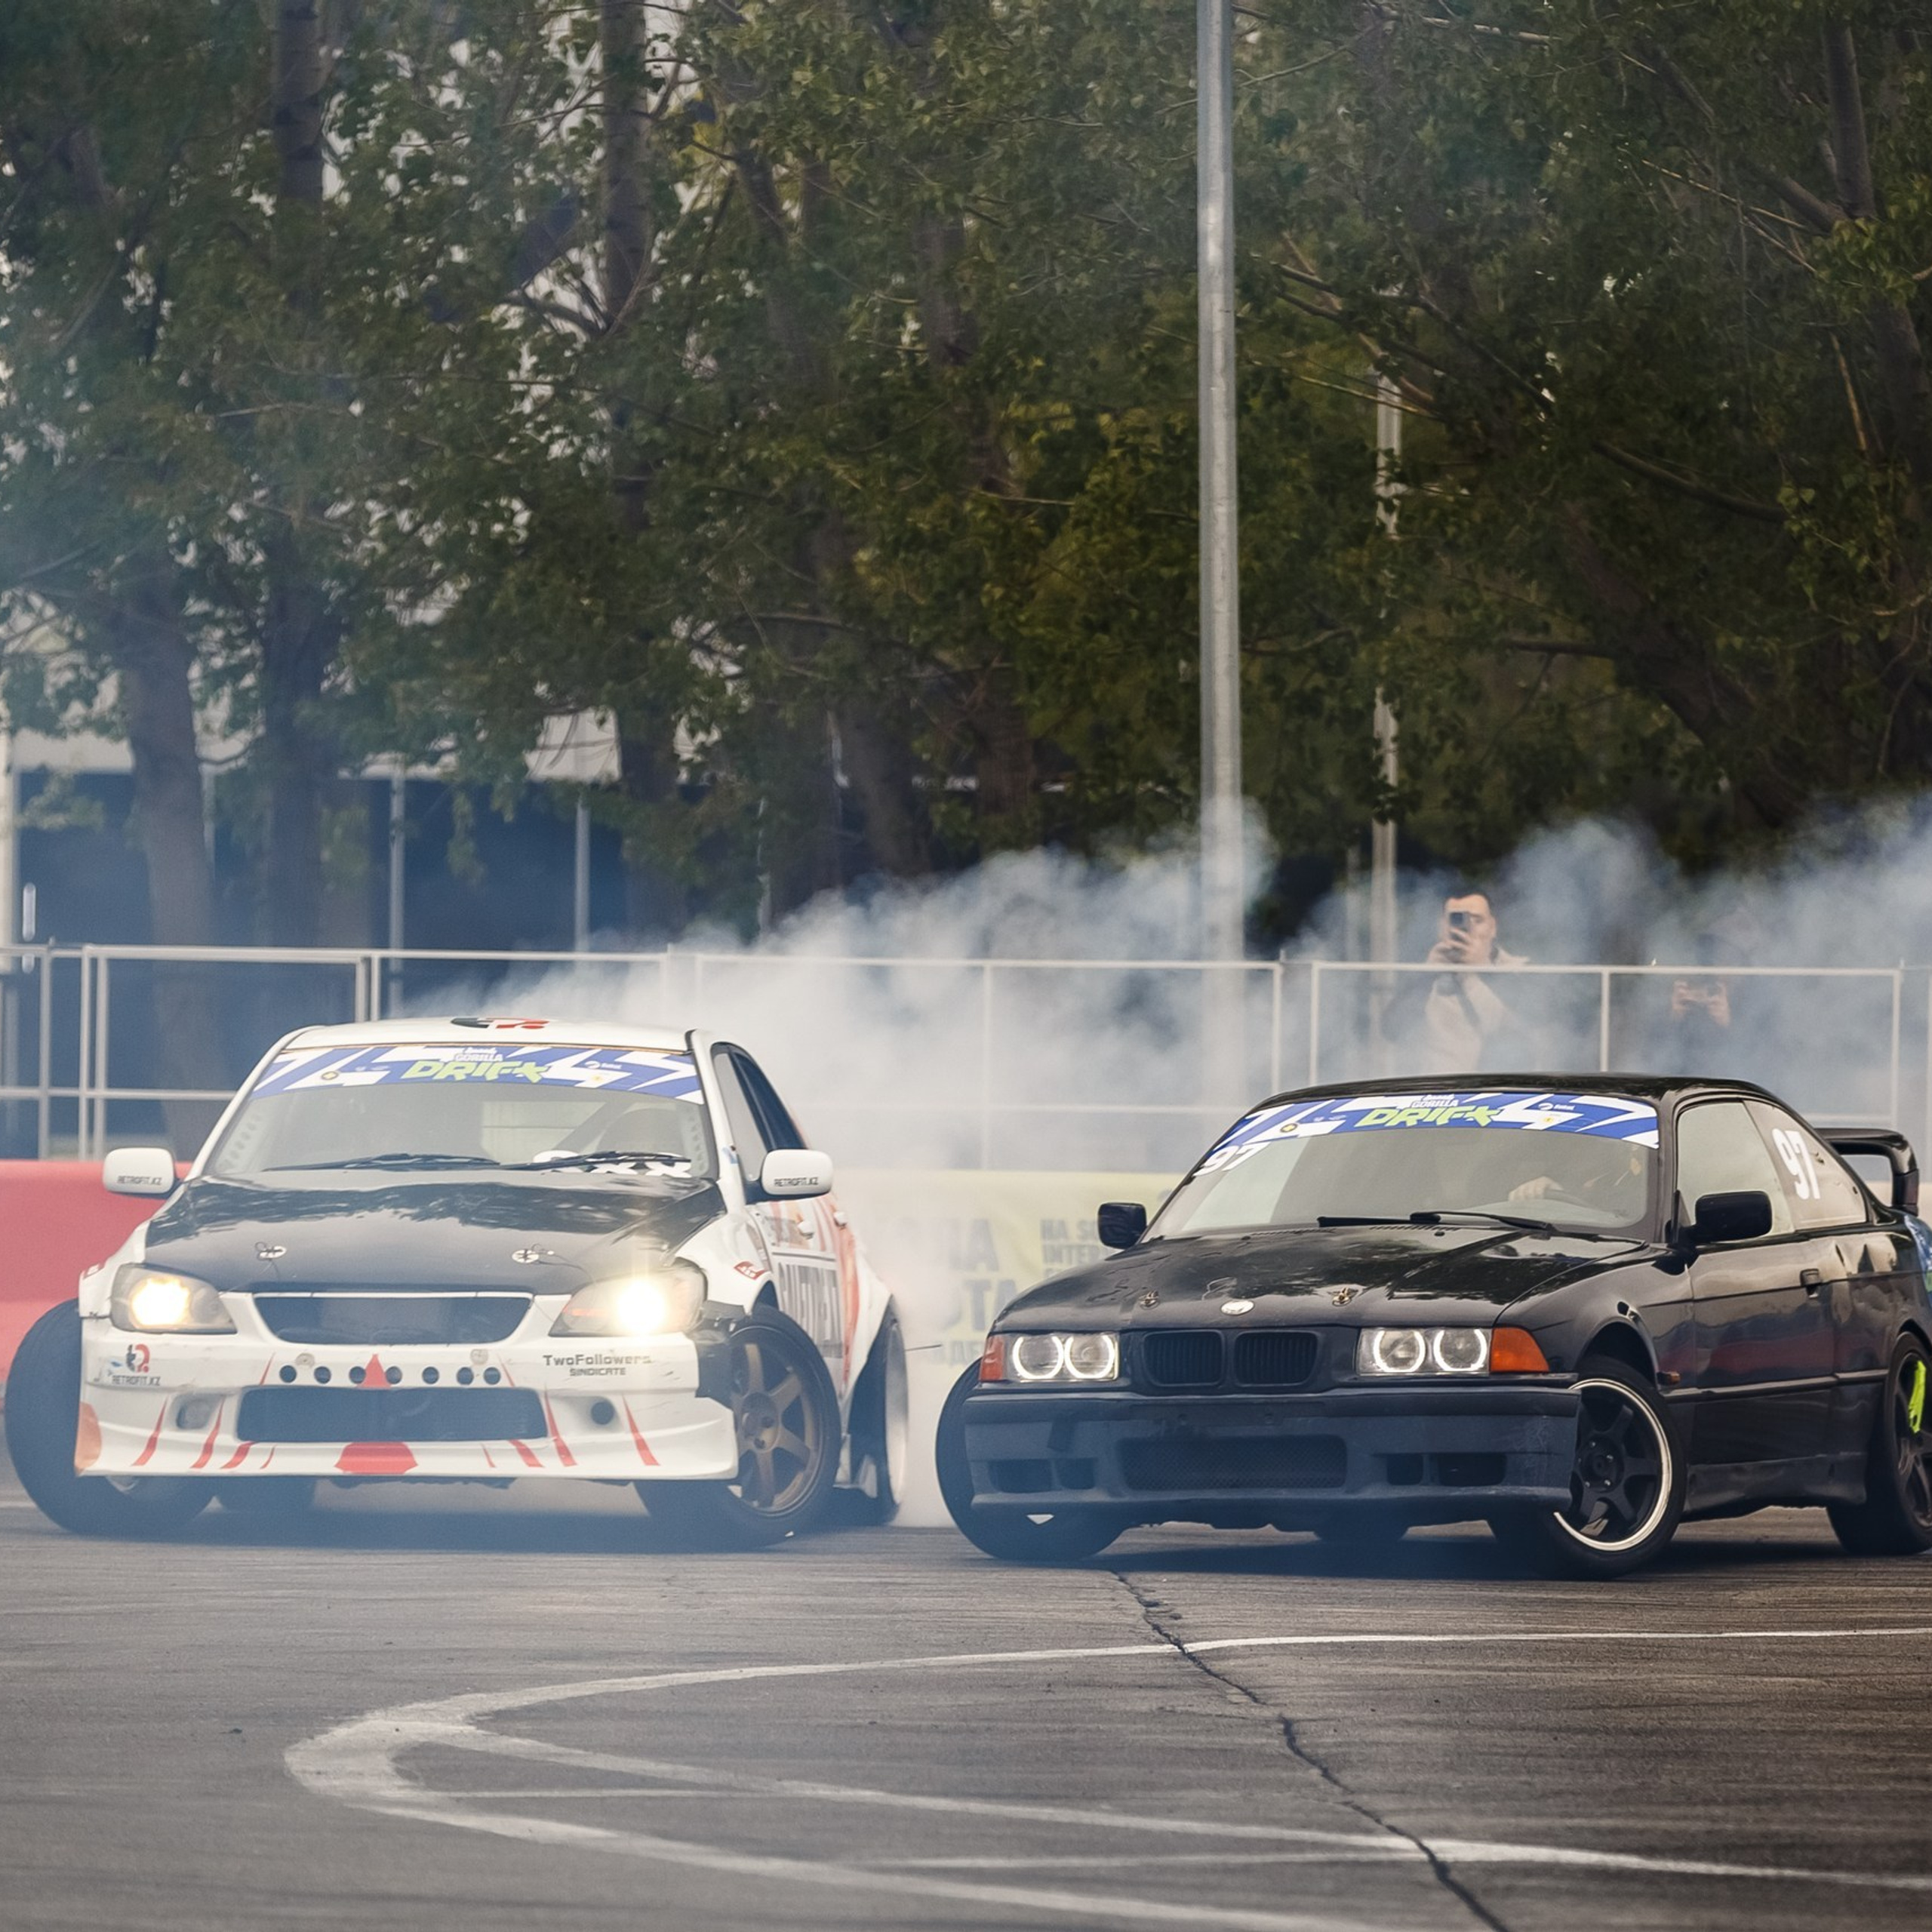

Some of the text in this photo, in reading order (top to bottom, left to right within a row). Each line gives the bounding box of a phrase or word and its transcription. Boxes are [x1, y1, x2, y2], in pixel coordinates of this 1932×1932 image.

[1192, 1141, 1272, 1177] 97
[1771, 1128, 1821, 1200] 97
[543, 1354, 652, 1366] TwoFollowers
[569, 1367, 626, 1377] SINDICATE
